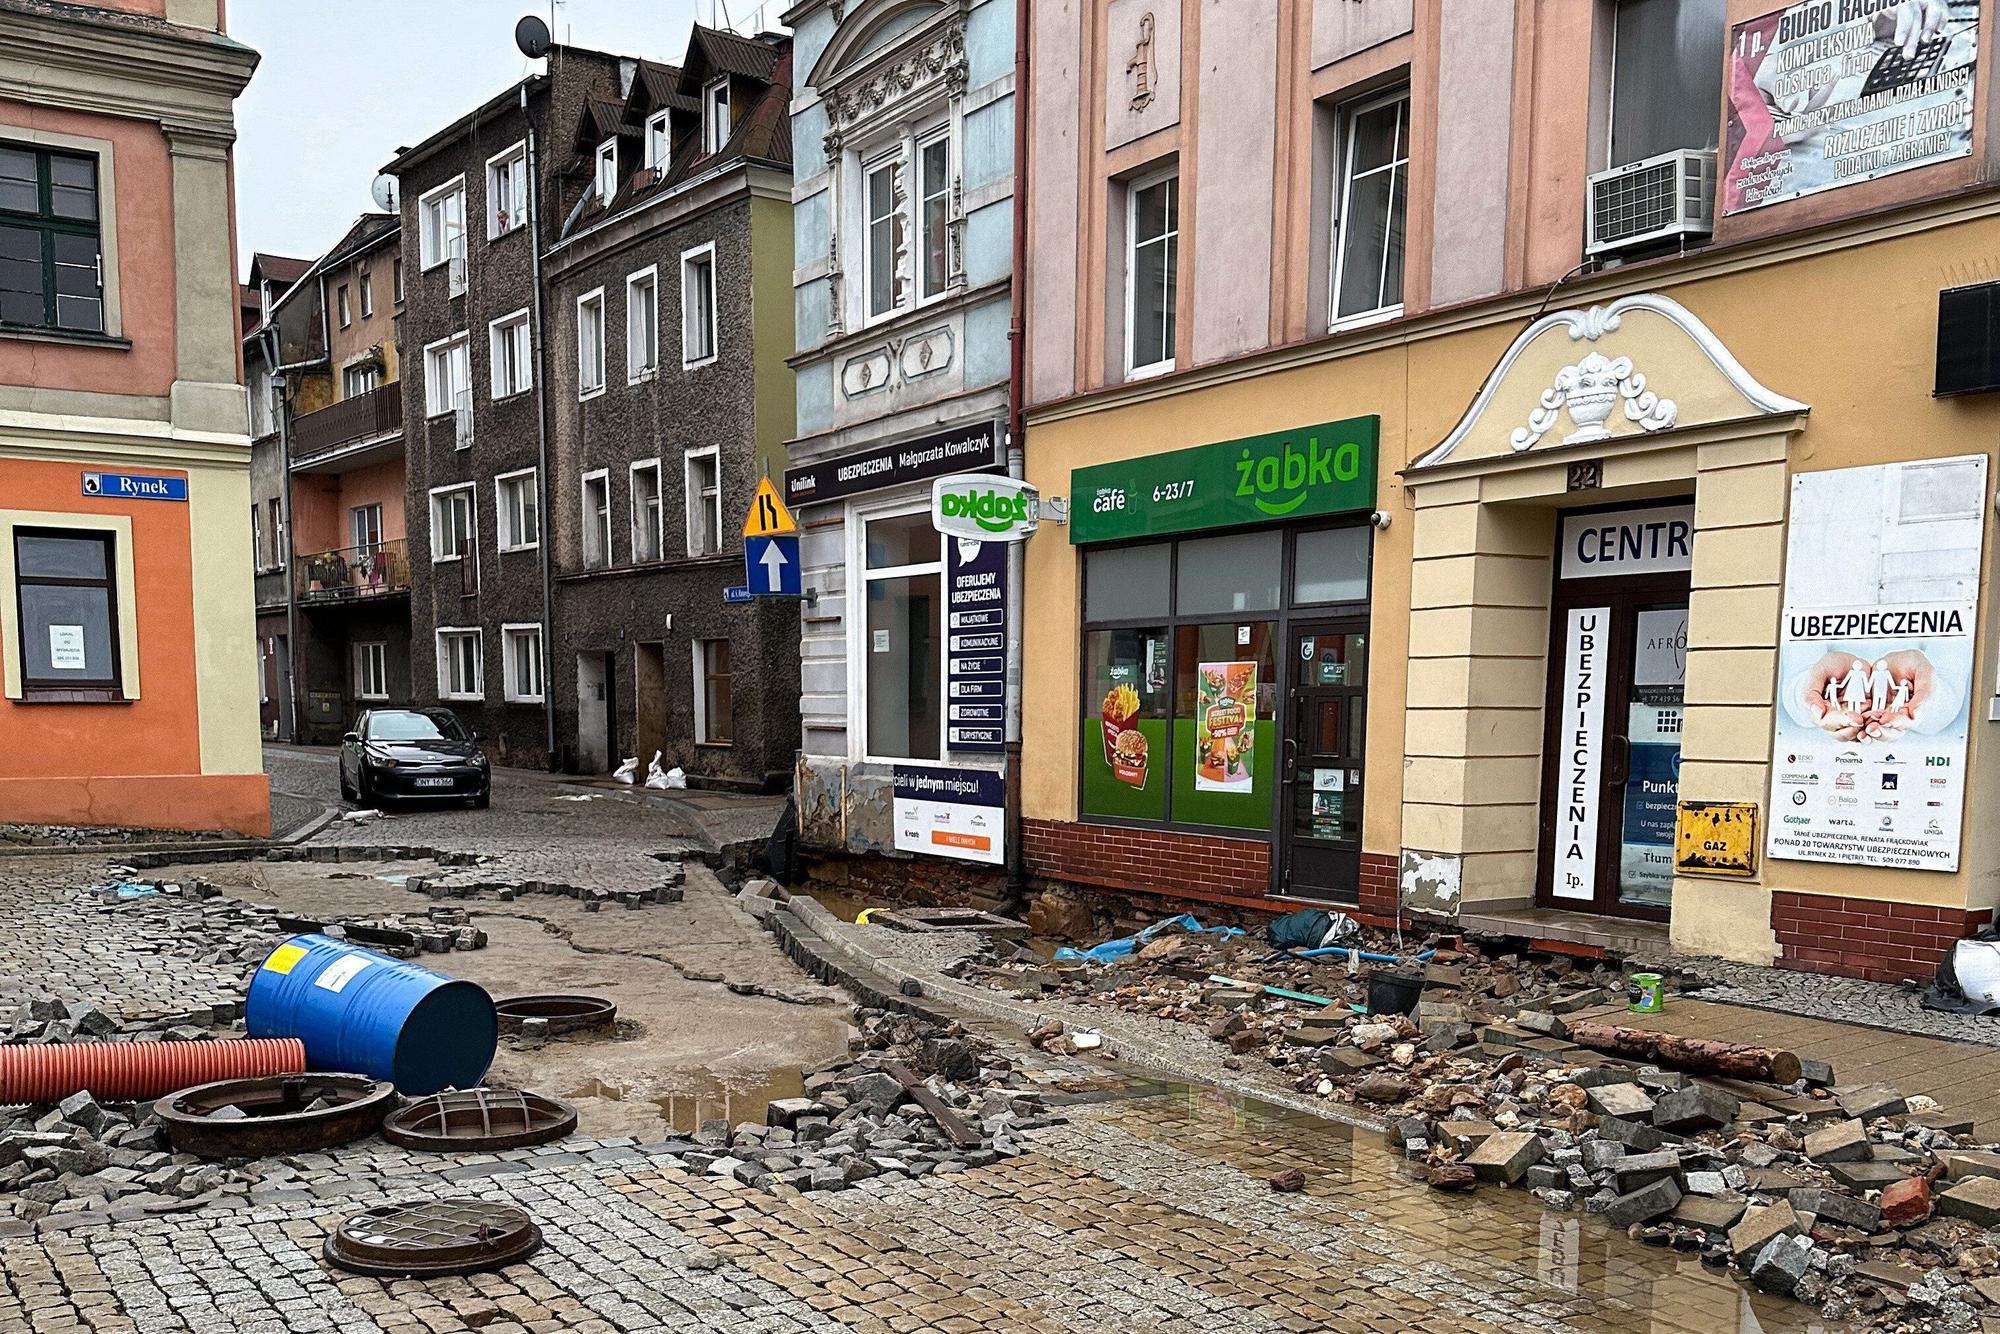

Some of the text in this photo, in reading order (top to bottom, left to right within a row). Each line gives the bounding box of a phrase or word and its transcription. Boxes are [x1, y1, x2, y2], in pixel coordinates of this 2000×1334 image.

[1779, 1, 1832, 44] BIURO
[1739, 31, 1764, 58] 1 p.
[1776, 22, 1874, 74] KOMPLEKSOWA
[1775, 52, 1872, 98] obsługa firm
[1773, 115, 1807, 138] POMOC
[1808, 106, 1831, 128] PRZY
[1833, 89, 1894, 122] ZAKŁADANIU
[1824, 98, 1967, 159] ROZLICZENIE i ZWROT
[1834, 150, 1880, 179] PODATKU
[1891, 131, 1952, 164] ZAGRANICY
[838, 433, 989, 481] UBEZPIECZENIA Małgorzata Kowalczyk
[1235, 437, 1361, 497] żabka
[120, 477, 168, 496] Rynek
[791, 475, 816, 492] Unilink
[1570, 466, 1595, 489] 22
[1152, 480, 1195, 502] 6-23/7
[1577, 520, 1694, 564] CENTR
[956, 572, 996, 588] OFERUJEMY
[951, 588, 1001, 603] UBEZPIECZENIA
[1790, 610, 1963, 637] UBEZPIECZENIA
[961, 660, 981, 671] NA ŻYCIE
[961, 684, 982, 694] DLA FIRM
[1209, 714, 1242, 727] FESTIVAL
[961, 731, 992, 741] TURYSTYCZNE
[1566, 614, 1597, 861] UBEZPIECZENIA
[1925, 756, 1950, 766] HDI
[916, 774, 944, 793] jednym
[945, 778, 979, 795] miejscu!
[1783, 815, 1811, 825] Gothaer
[1703, 842, 1727, 851] GAZ
[1774, 838, 1801, 846] PONAD
[1813, 841, 1865, 852] TOWARZYSTW
[1866, 845, 1950, 859] UBEZPIECZENIOWYCH
[1812, 832, 1859, 841] UBEZPIECZENIA,
[1886, 838, 1929, 847] FRĄCKOWIAK
